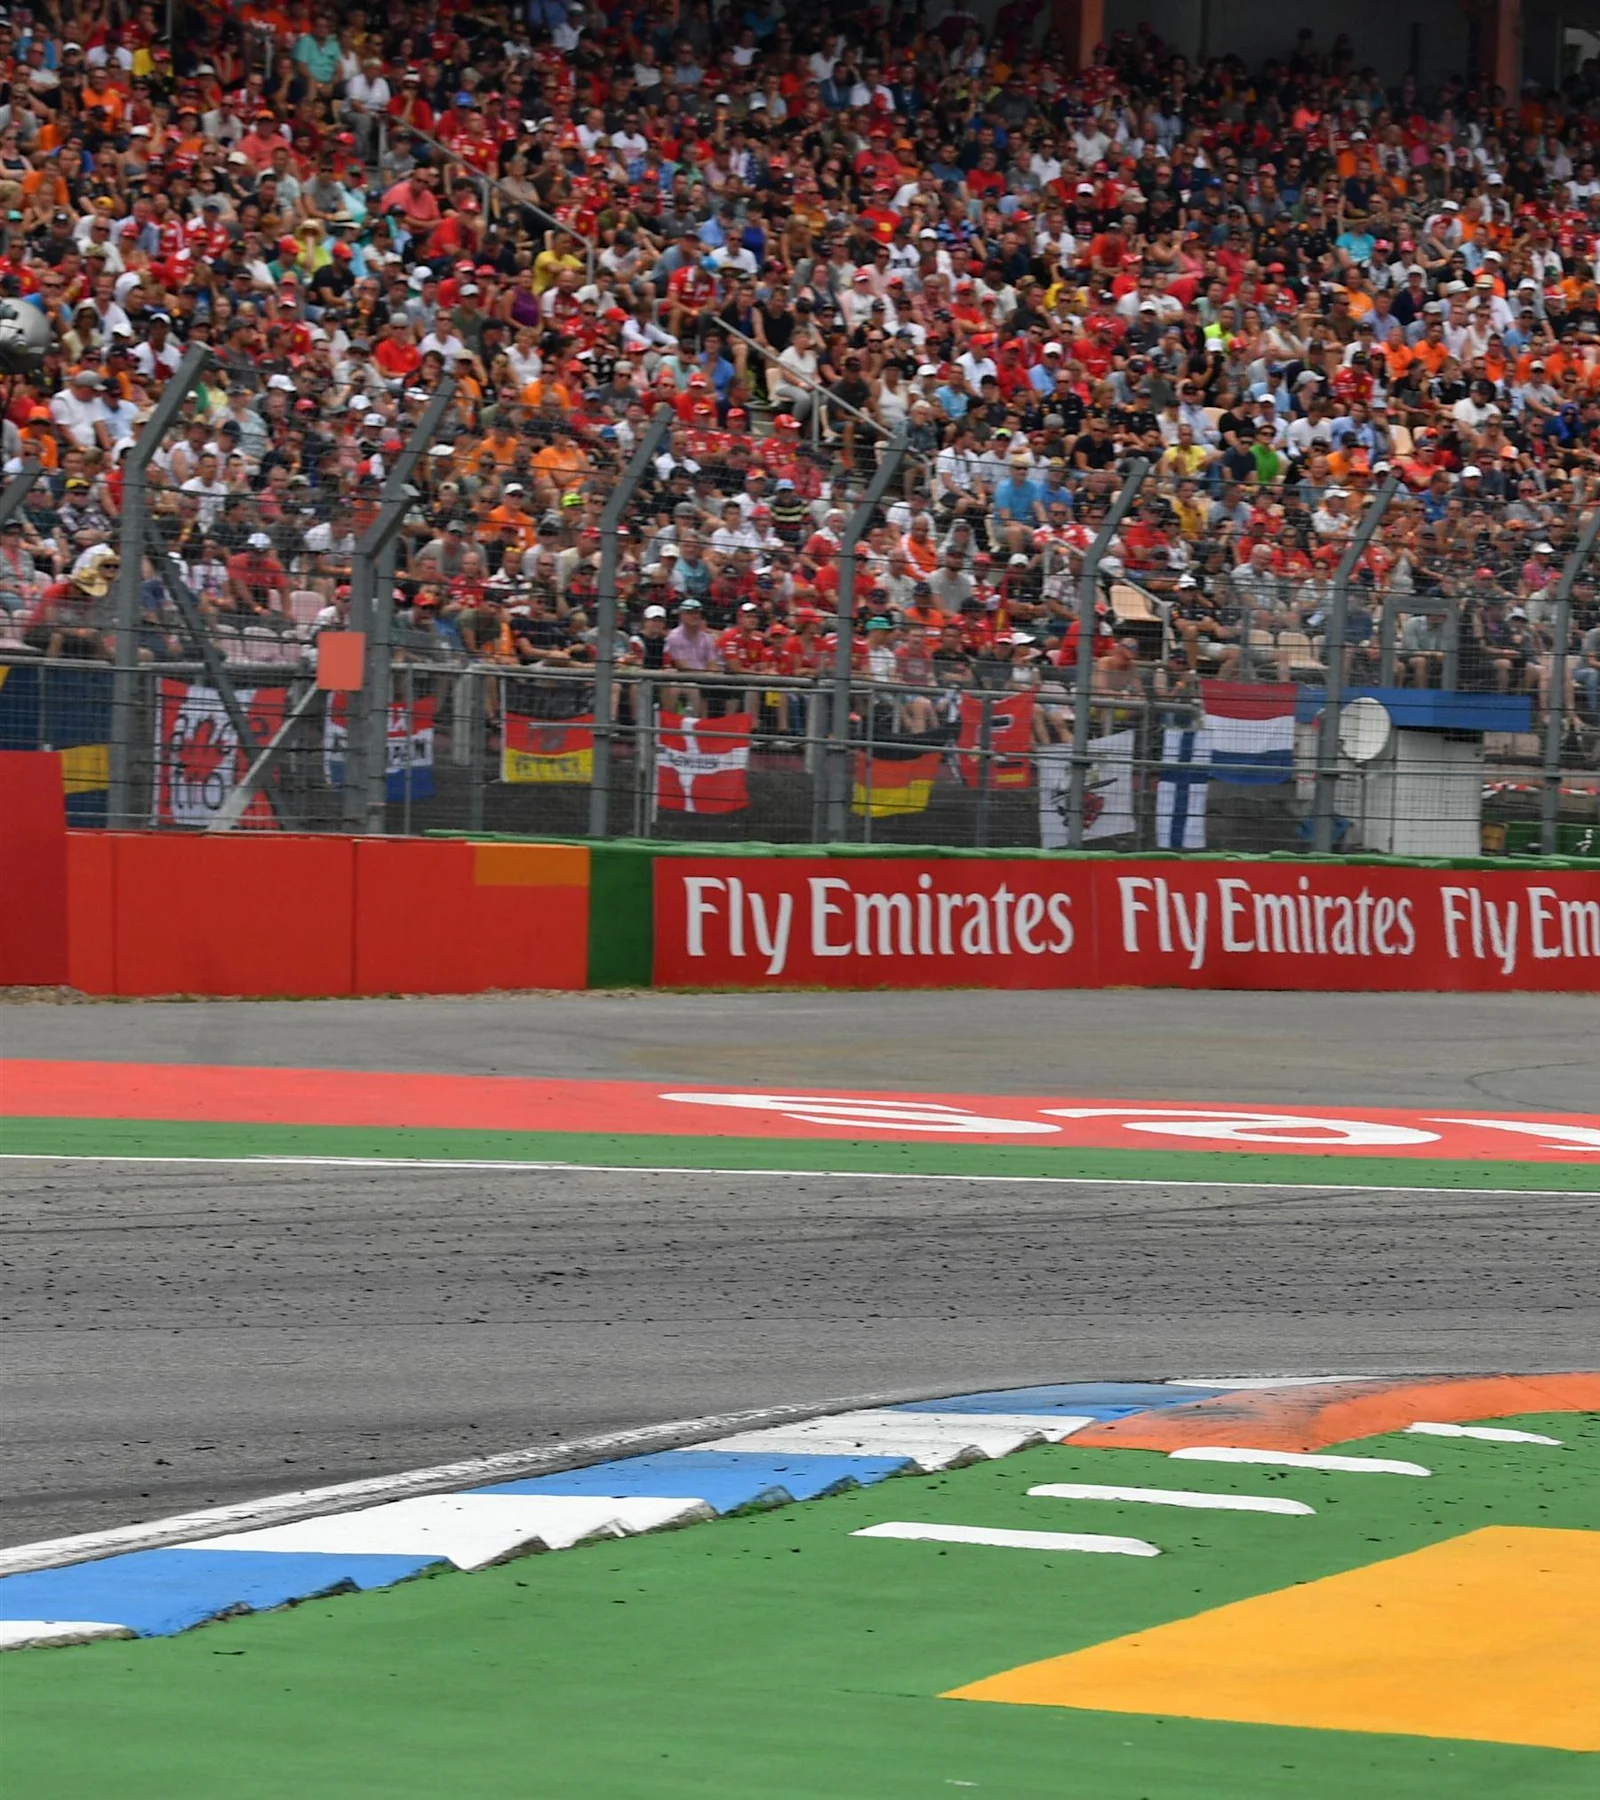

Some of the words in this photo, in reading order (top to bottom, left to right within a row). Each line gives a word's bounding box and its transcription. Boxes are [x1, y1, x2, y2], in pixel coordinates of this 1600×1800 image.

[684, 877, 793, 974] Fly
[808, 874, 1073, 956] Emirates
[1118, 877, 1207, 969] Fly
[1218, 876, 1414, 955] Emirates
[1441, 887, 1518, 975] Fly
